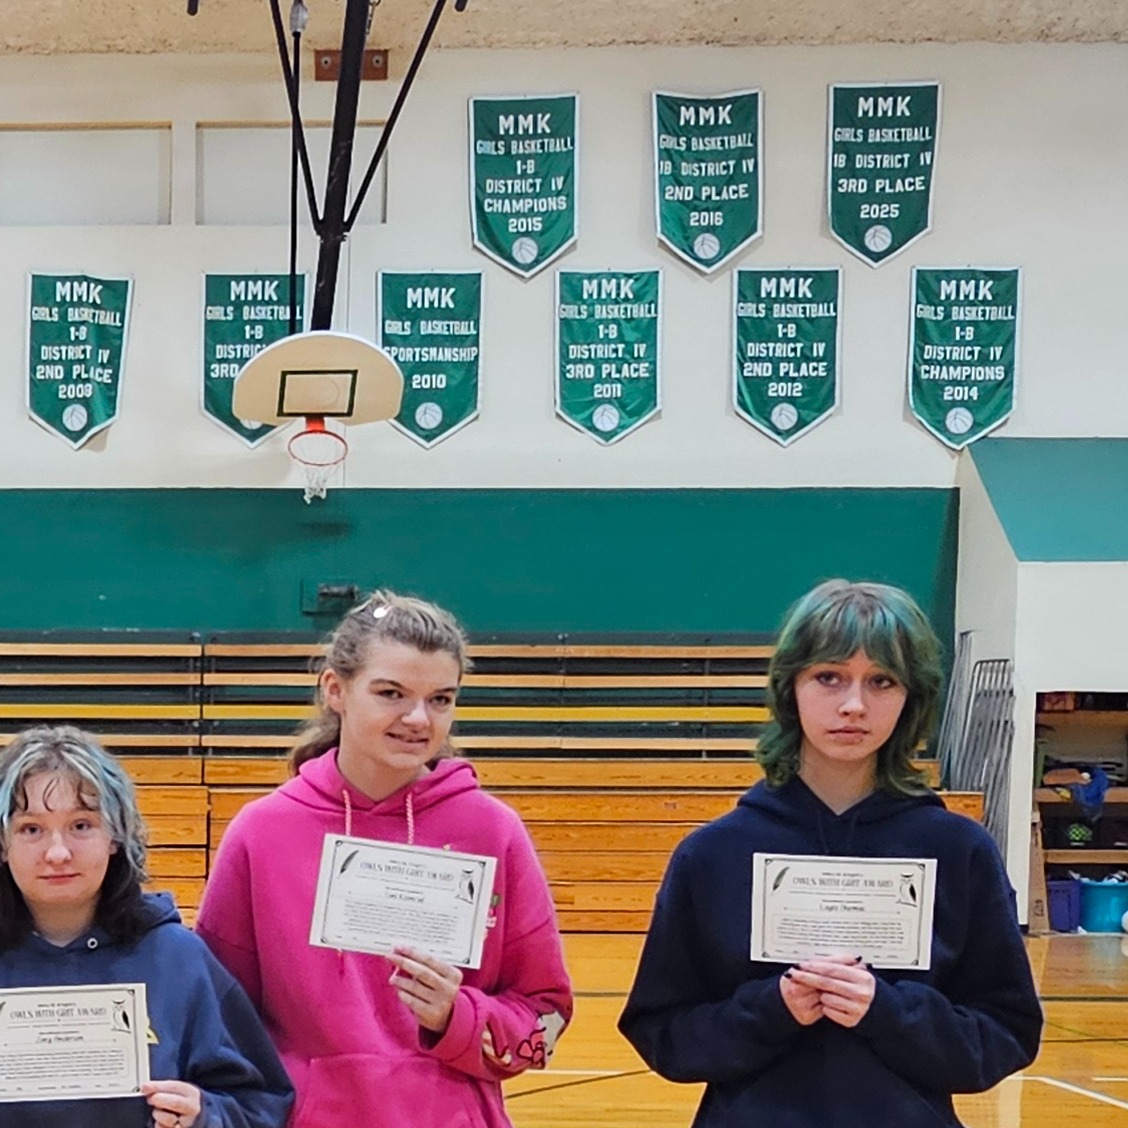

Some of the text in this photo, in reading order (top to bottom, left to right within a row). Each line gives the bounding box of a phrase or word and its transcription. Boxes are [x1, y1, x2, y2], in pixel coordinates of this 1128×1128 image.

[858, 96, 910, 117] MMK
[680, 105, 731, 125] MMK
[499, 114, 550, 134] MMK
[660, 133, 753, 150] GIRLS BASKETBALL
[835, 127, 931, 142] GIRLS BASKETBALL
[477, 137, 573, 154] GIRLS BASKETBALL
[517, 160, 534, 174] 1-B
[660, 158, 754, 176] 1B DISTRICT IV
[834, 152, 931, 168] 1B DISTRICT IV
[486, 176, 563, 193] DISTRICT IV
[838, 176, 925, 192] 3RD PLACE
[665, 184, 748, 200] 2ND PLACE
[484, 196, 566, 213] CHAMPIONS
[860, 204, 899, 218] 2025
[509, 217, 542, 232] 2015
[690, 212, 723, 225] 2016
[56, 282, 102, 304] MMK
[230, 280, 279, 301] MMK
[583, 279, 634, 299] MMK
[761, 278, 812, 298] MMK
[940, 280, 993, 300] MMK
[407, 287, 455, 308] MMK
[32, 307, 121, 326] GIRLS BASKETBALL
[206, 306, 302, 320] GIRLS BASKETBAL
[560, 304, 657, 318] GIRLS BASKETBALL
[738, 303, 836, 317] GIRLS BASKETBALL
[917, 304, 1014, 320] GIRLS BASKETBALL
[245, 325, 263, 339] 1-B
[385, 320, 476, 334] GIRLS BASKETBALL
[599, 324, 617, 338] 1-B
[778, 324, 796, 337] 1-B
[956, 327, 974, 340] 1-B
[41, 345, 110, 363] DISTRICT IV
[569, 344, 646, 358] DISTRICT IV
[747, 343, 825, 357] DISTRICT IV
[924, 345, 1002, 360] DISTRICT IV
[37, 364, 112, 383] 2ND PLACE
[211, 364, 239, 378] 3RD
[566, 363, 649, 378] 3RD PLACE
[744, 362, 827, 377] 2ND PLACE
[921, 365, 1004, 380] CHAMPIONS
[413, 375, 446, 388] 2010
[594, 384, 621, 397] 2011
[769, 383, 802, 396] 2012
[944, 386, 978, 400] 2014
